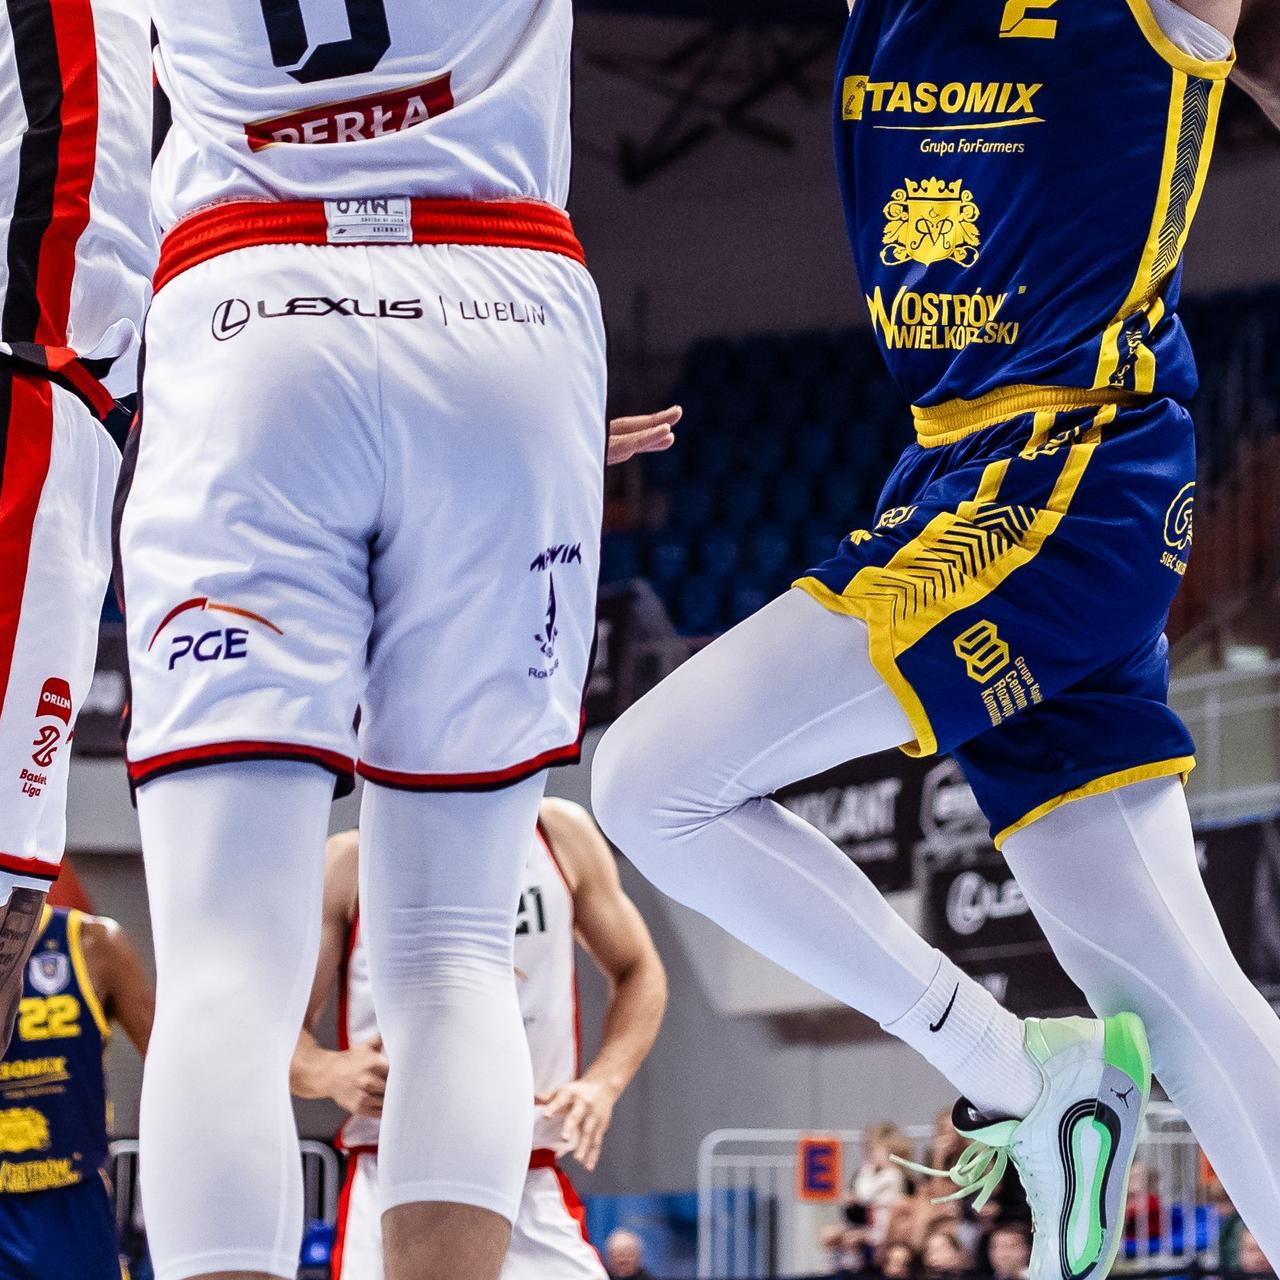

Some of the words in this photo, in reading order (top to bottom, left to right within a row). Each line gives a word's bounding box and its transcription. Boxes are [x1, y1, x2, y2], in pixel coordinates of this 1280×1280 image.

[865, 81, 1044, 114] TASOMIX
[920, 138, 955, 157] Grupa
[957, 138, 1026, 153] ForFarmers
[257, 296, 423, 320] LEXUS
[459, 300, 546, 326] LUBLIN
[168, 627, 250, 671] PGE
[1014, 655, 1035, 686] Grupa
[42, 691, 72, 710] ORLEN
[1005, 669, 1028, 711] Centrum
[21, 782, 42, 798] Liga
[19, 994, 81, 1041] 22
[803, 1146, 835, 1193] E
